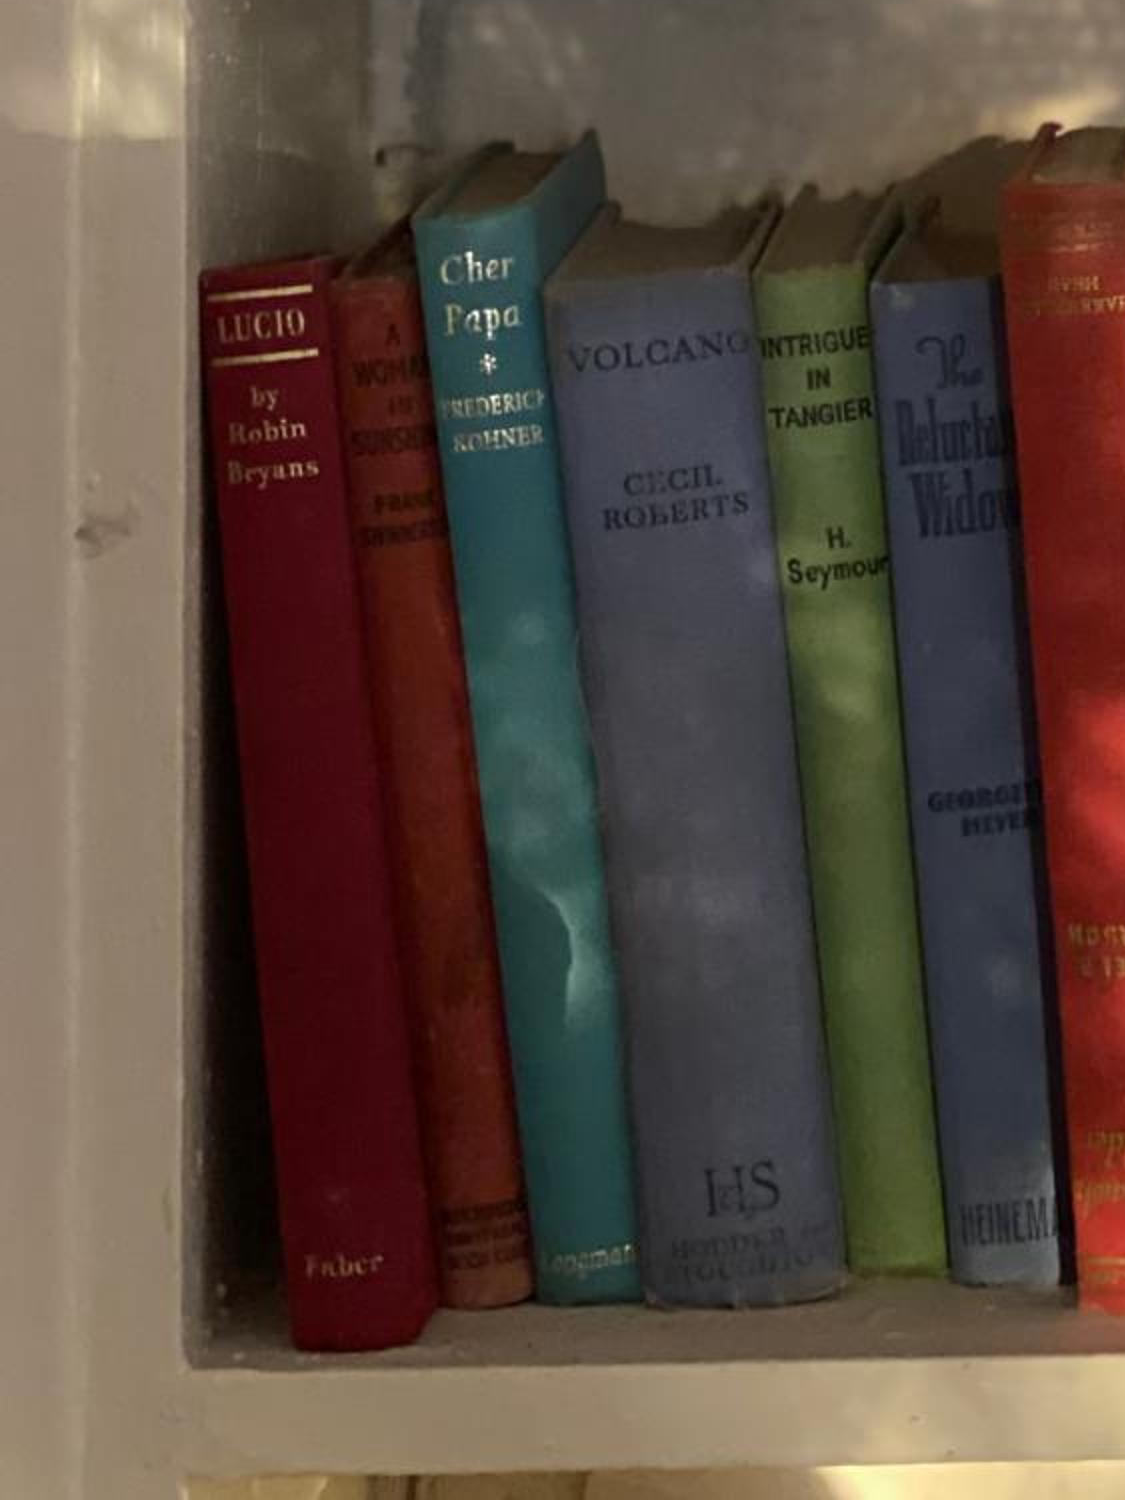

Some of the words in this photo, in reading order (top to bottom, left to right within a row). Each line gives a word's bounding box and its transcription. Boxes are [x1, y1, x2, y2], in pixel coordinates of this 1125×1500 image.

[440, 250, 515, 285] Cher
[216, 307, 307, 345] LUCIO
[445, 303, 523, 340] Papa
[760, 326, 873, 358] INTRIGUE
[914, 333, 984, 390] The
[806, 368, 831, 390] IN
[250, 386, 279, 410] by
[768, 398, 872, 428] TANGIER
[228, 418, 307, 445] Robin
[227, 459, 320, 490] Bryans
[623, 464, 723, 497] CECIL
[602, 491, 749, 531] ROBERTS
[825, 526, 851, 549] H.
[304, 1254, 385, 1279] Faber
